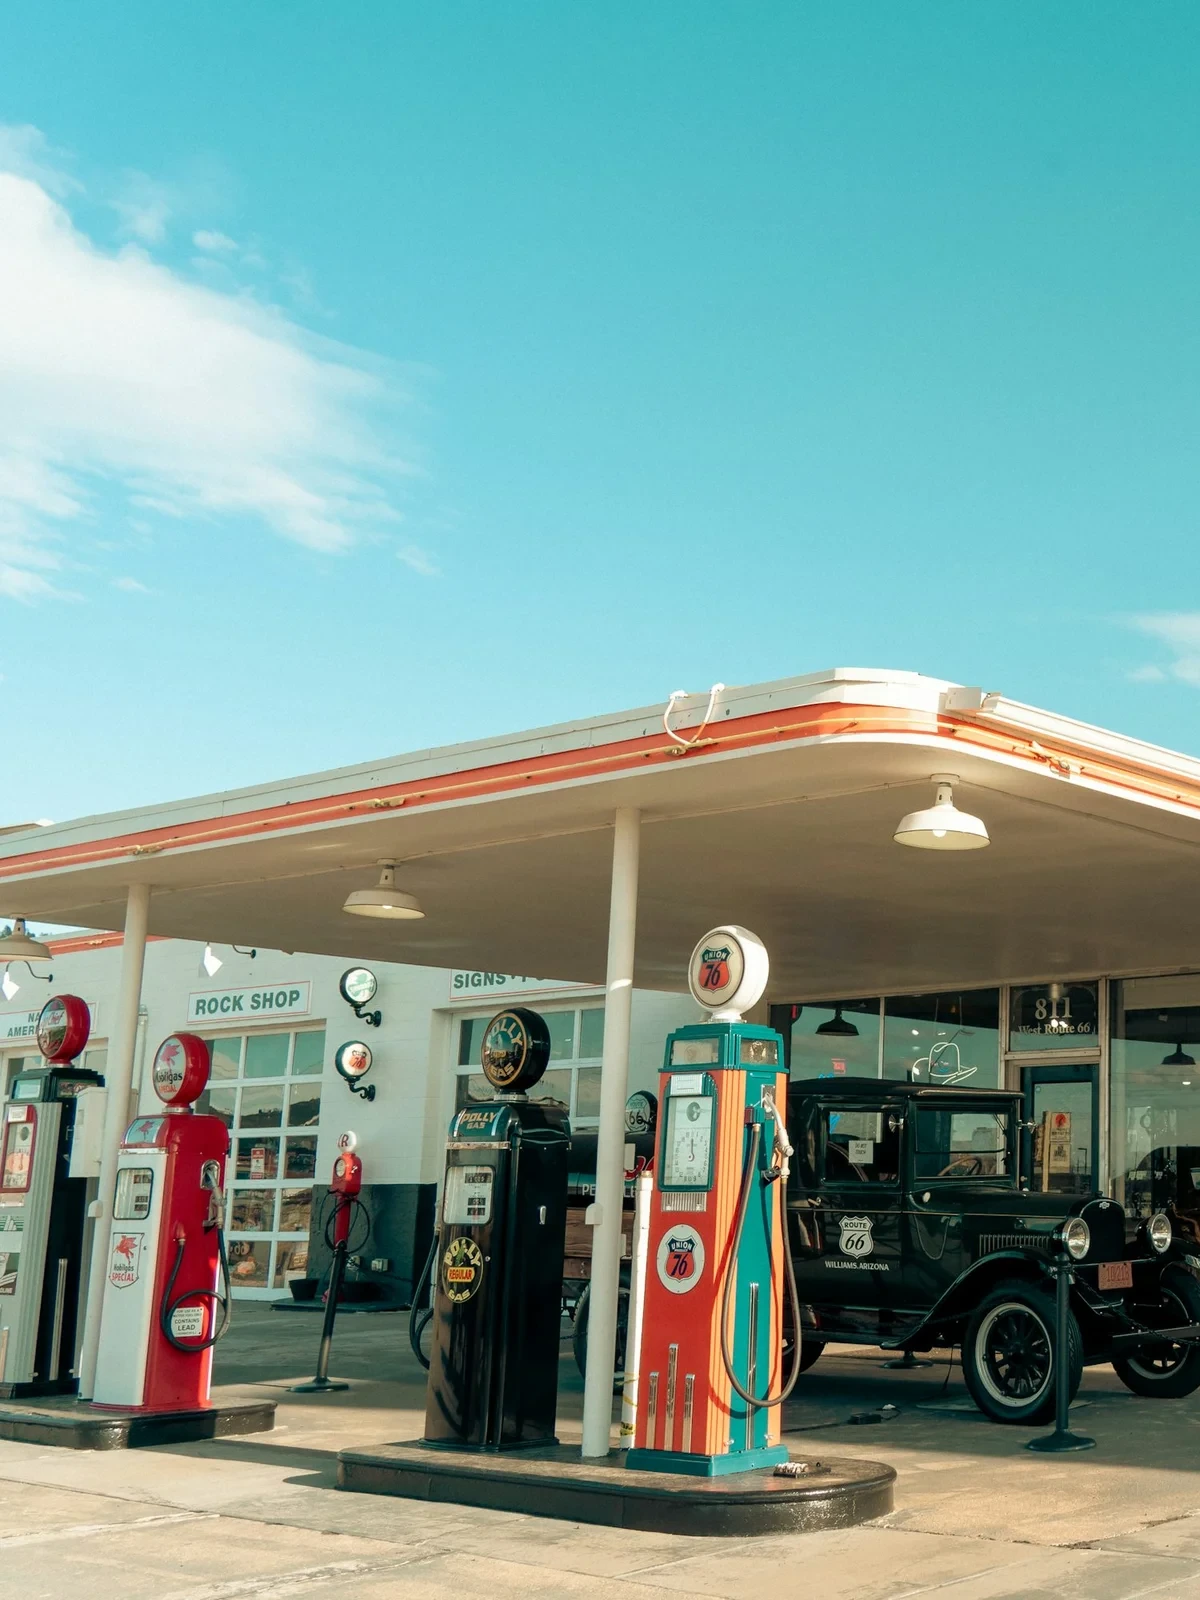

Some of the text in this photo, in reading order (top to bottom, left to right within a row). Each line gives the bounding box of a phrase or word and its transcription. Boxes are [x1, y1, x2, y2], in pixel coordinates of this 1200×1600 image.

[704, 951, 727, 960] UNION
[453, 972, 506, 988] SIGNS
[704, 962, 721, 986] 76
[195, 990, 300, 1015] ROCK SHOP
[1035, 997, 1072, 1020] 811
[1077, 1022, 1090, 1033] 66
[460, 1112, 497, 1123] POLLY
[629, 1110, 644, 1125] 66
[671, 1241, 692, 1250] UNION
[845, 1233, 867, 1250] 66
[444, 1239, 480, 1266] POLLY
[671, 1254, 688, 1276] 76
[858, 1262, 890, 1271] ARIZONA
[111, 1273, 134, 1282] SPECIAL
[449, 1268, 473, 1280] REGULAR
[448, 1289, 471, 1300] GAS
